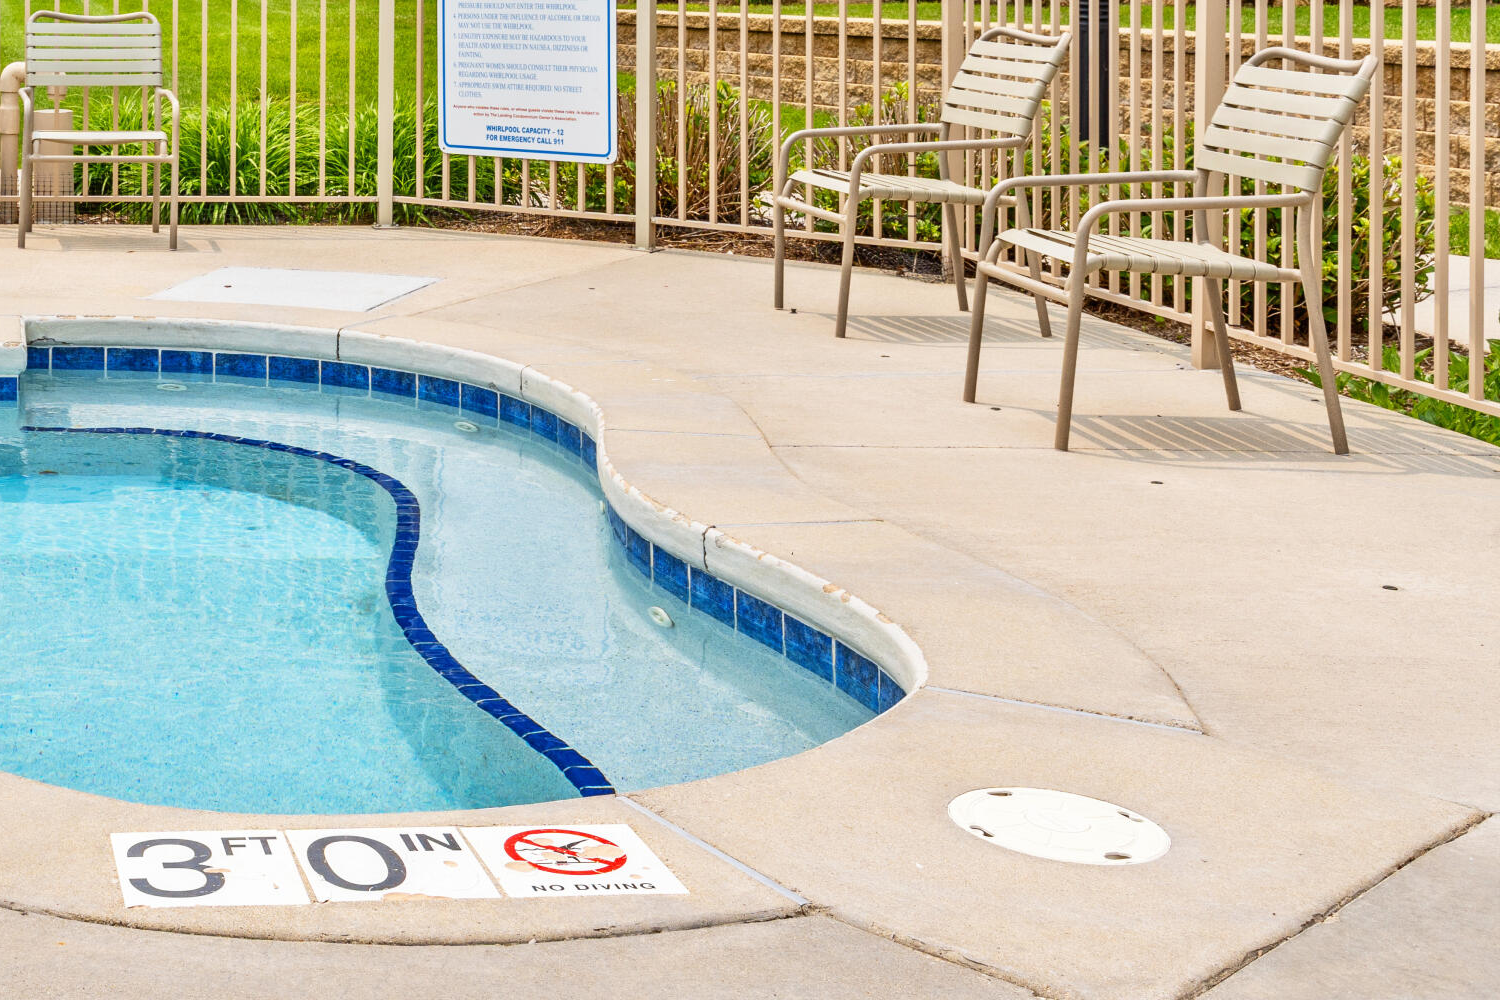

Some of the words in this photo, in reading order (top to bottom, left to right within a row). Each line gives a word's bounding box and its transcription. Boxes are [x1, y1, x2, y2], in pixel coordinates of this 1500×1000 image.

[486, 125, 519, 133] WHIRLPOOL
[500, 135, 535, 143] EMERGENCY
[127, 838, 225, 898] 3
[221, 836, 277, 855] FT
[307, 835, 407, 892] 0
[400, 833, 462, 851] IN
[532, 884, 565, 892] NO
[575, 882, 657, 891] DIVING
